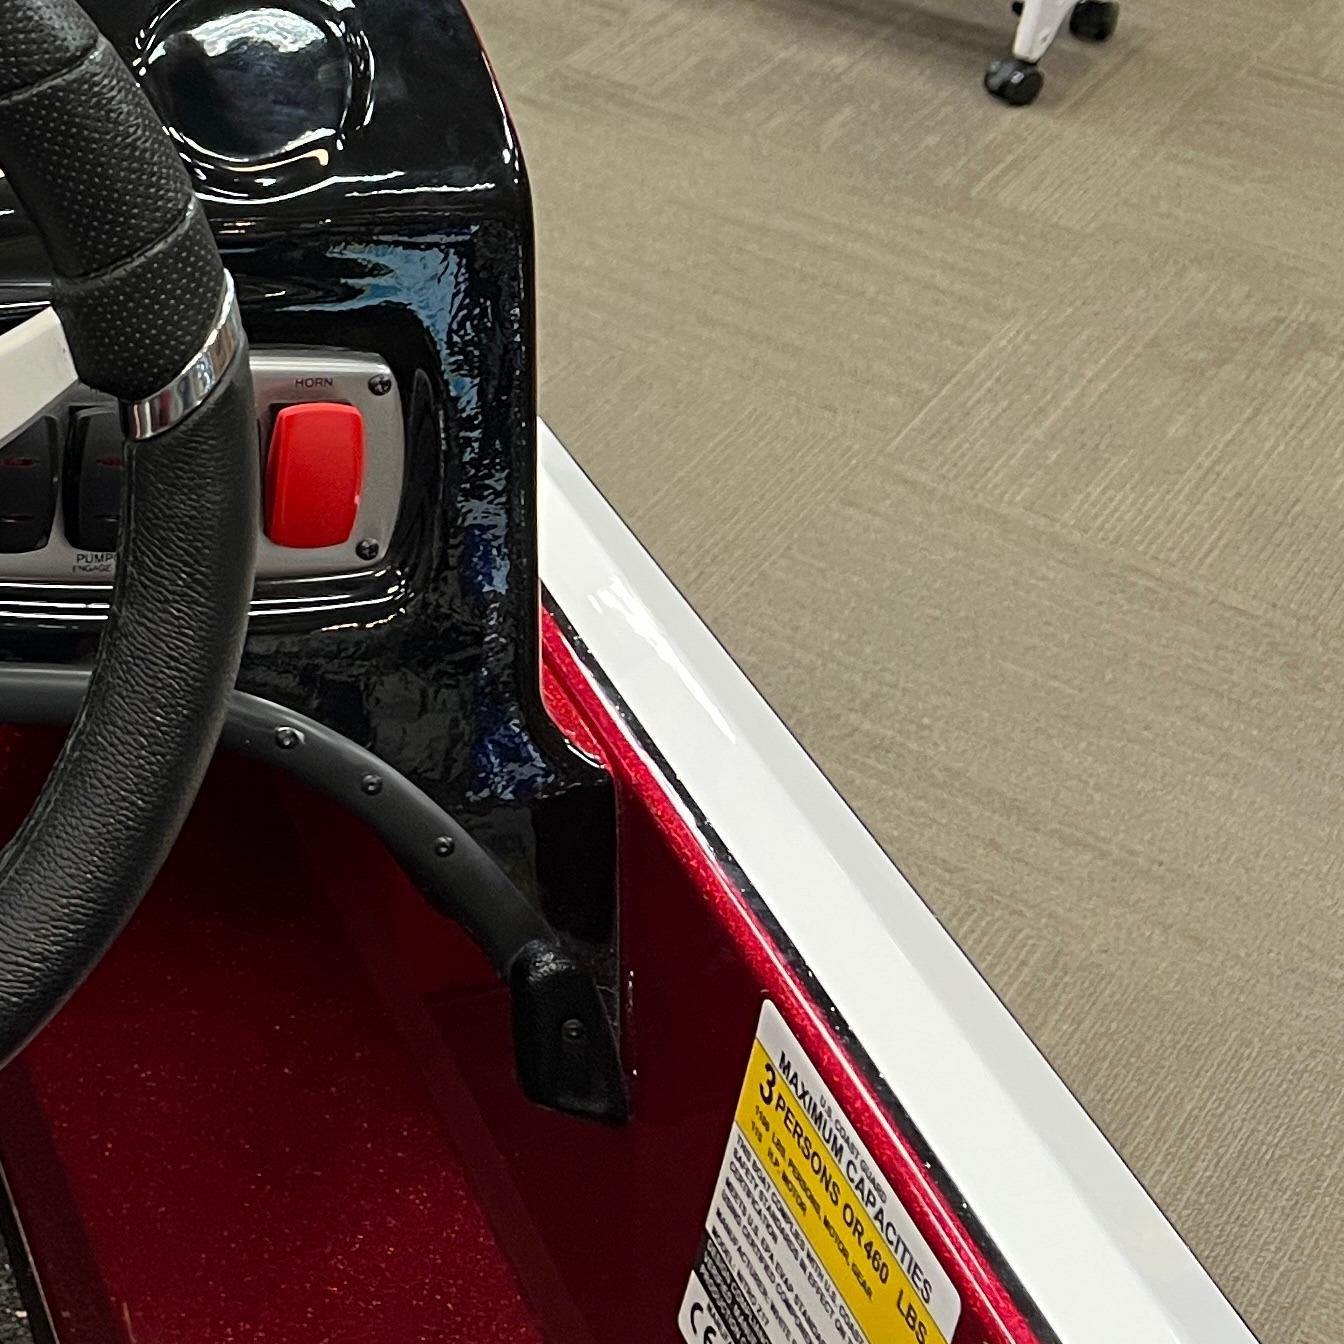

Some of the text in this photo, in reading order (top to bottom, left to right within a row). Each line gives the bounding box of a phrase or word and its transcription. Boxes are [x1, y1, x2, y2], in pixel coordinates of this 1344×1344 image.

[295, 378, 333, 388] HORN
[759, 1063, 775, 1104] 3
[775, 1095, 839, 1204] PERSONS
[842, 1203, 863, 1245] OR
[864, 1241, 888, 1283] 460
[896, 1290, 926, 1344] LBS
[779, 1053, 930, 1301] MAXIMUM CAPACITIES
[819, 1094, 886, 1203] U.S. COAST GUARD
